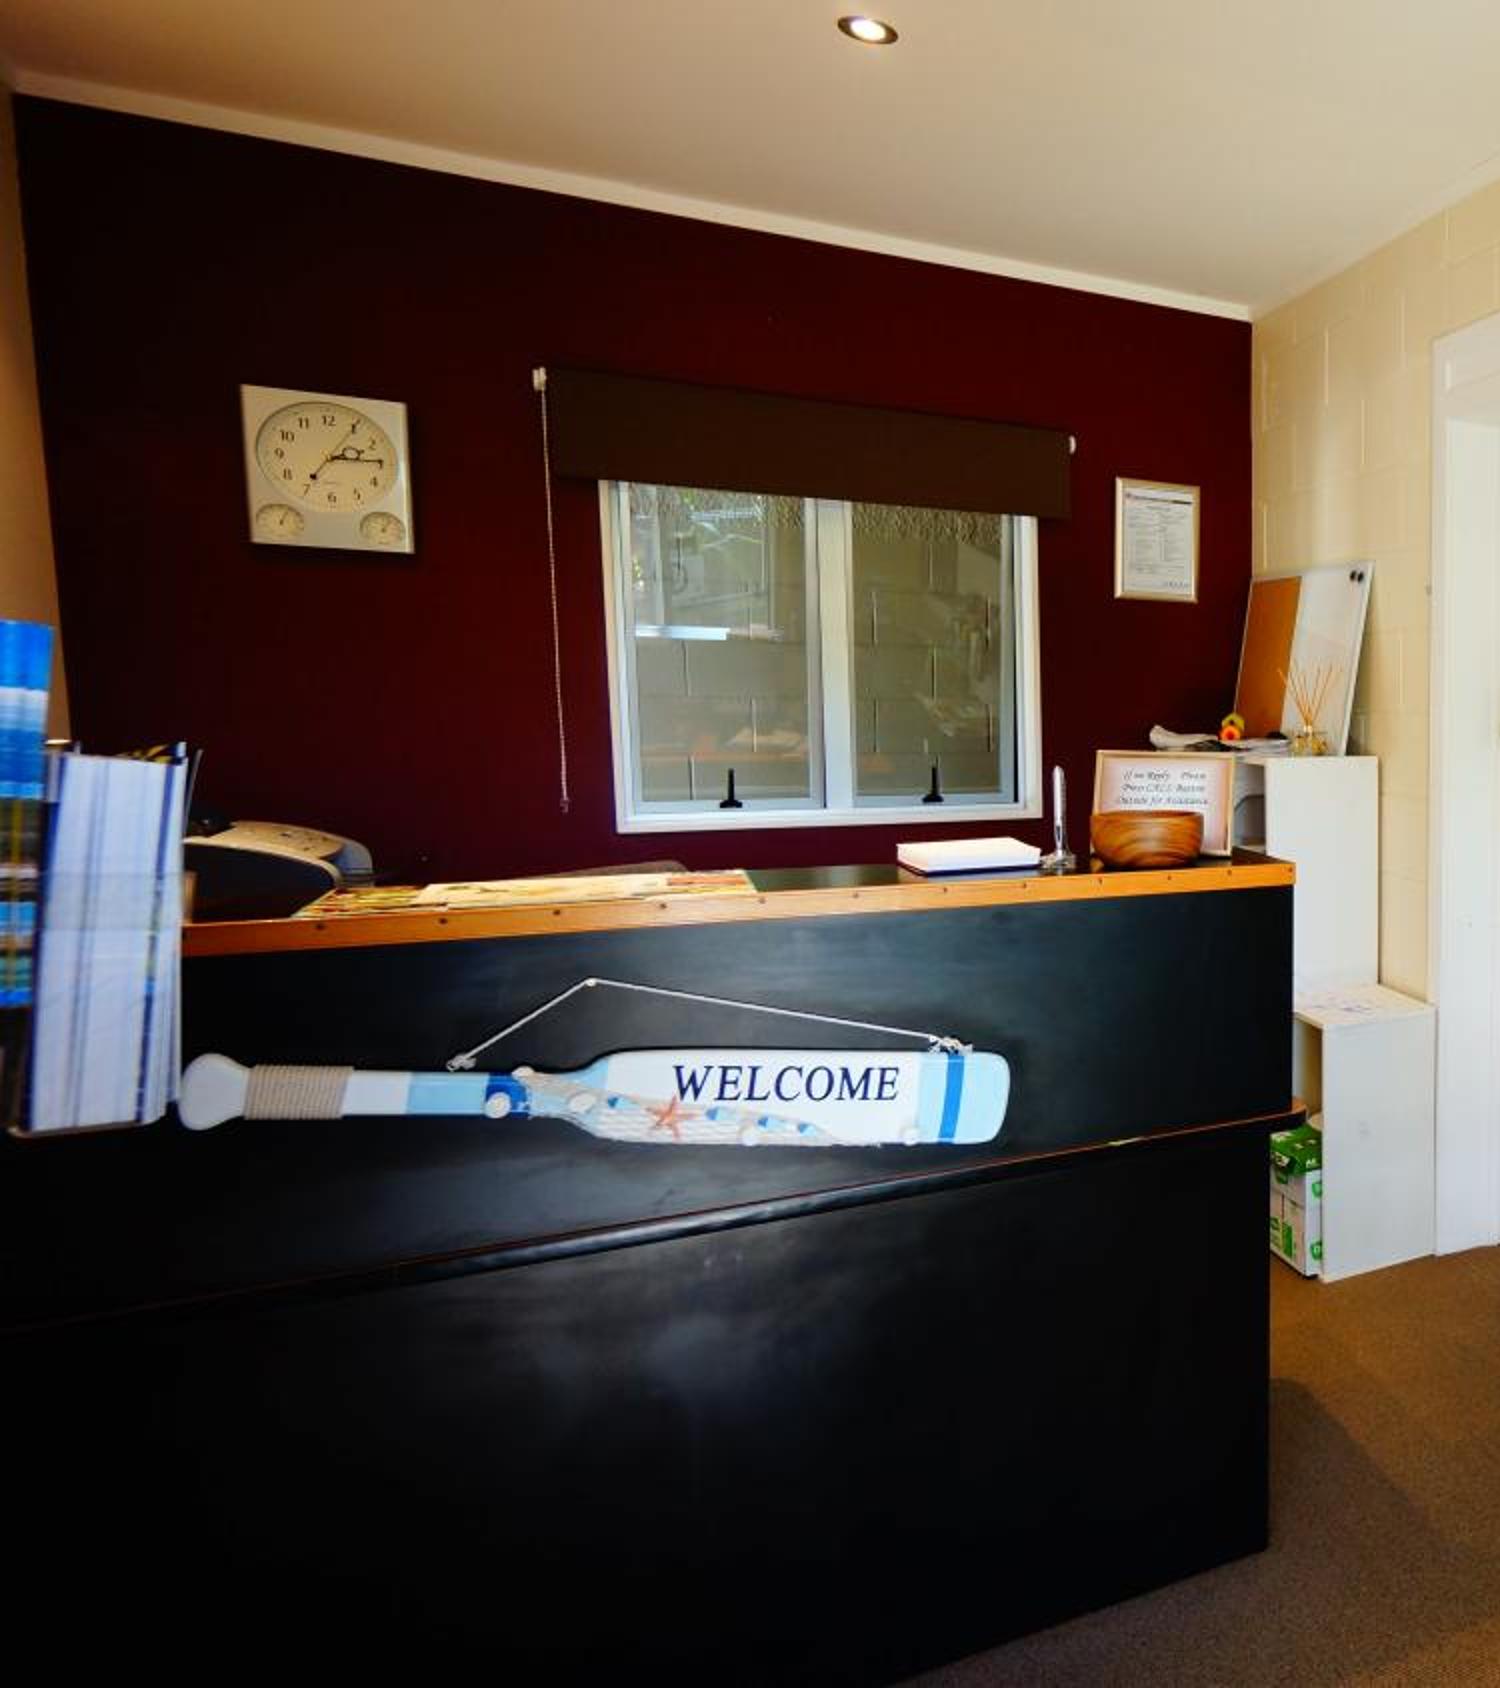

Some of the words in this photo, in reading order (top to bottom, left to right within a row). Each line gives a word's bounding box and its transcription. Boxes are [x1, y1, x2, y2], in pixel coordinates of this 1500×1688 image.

[298, 417, 310, 429] 11
[321, 415, 336, 427] 12
[280, 429, 295, 442] 10
[369, 438, 377, 450] 2
[274, 448, 284, 459] 9
[370, 477, 378, 488] 4
[303, 484, 311, 496] 7
[327, 492, 337, 503] 6
[673, 1064, 900, 1101] WELCOME
